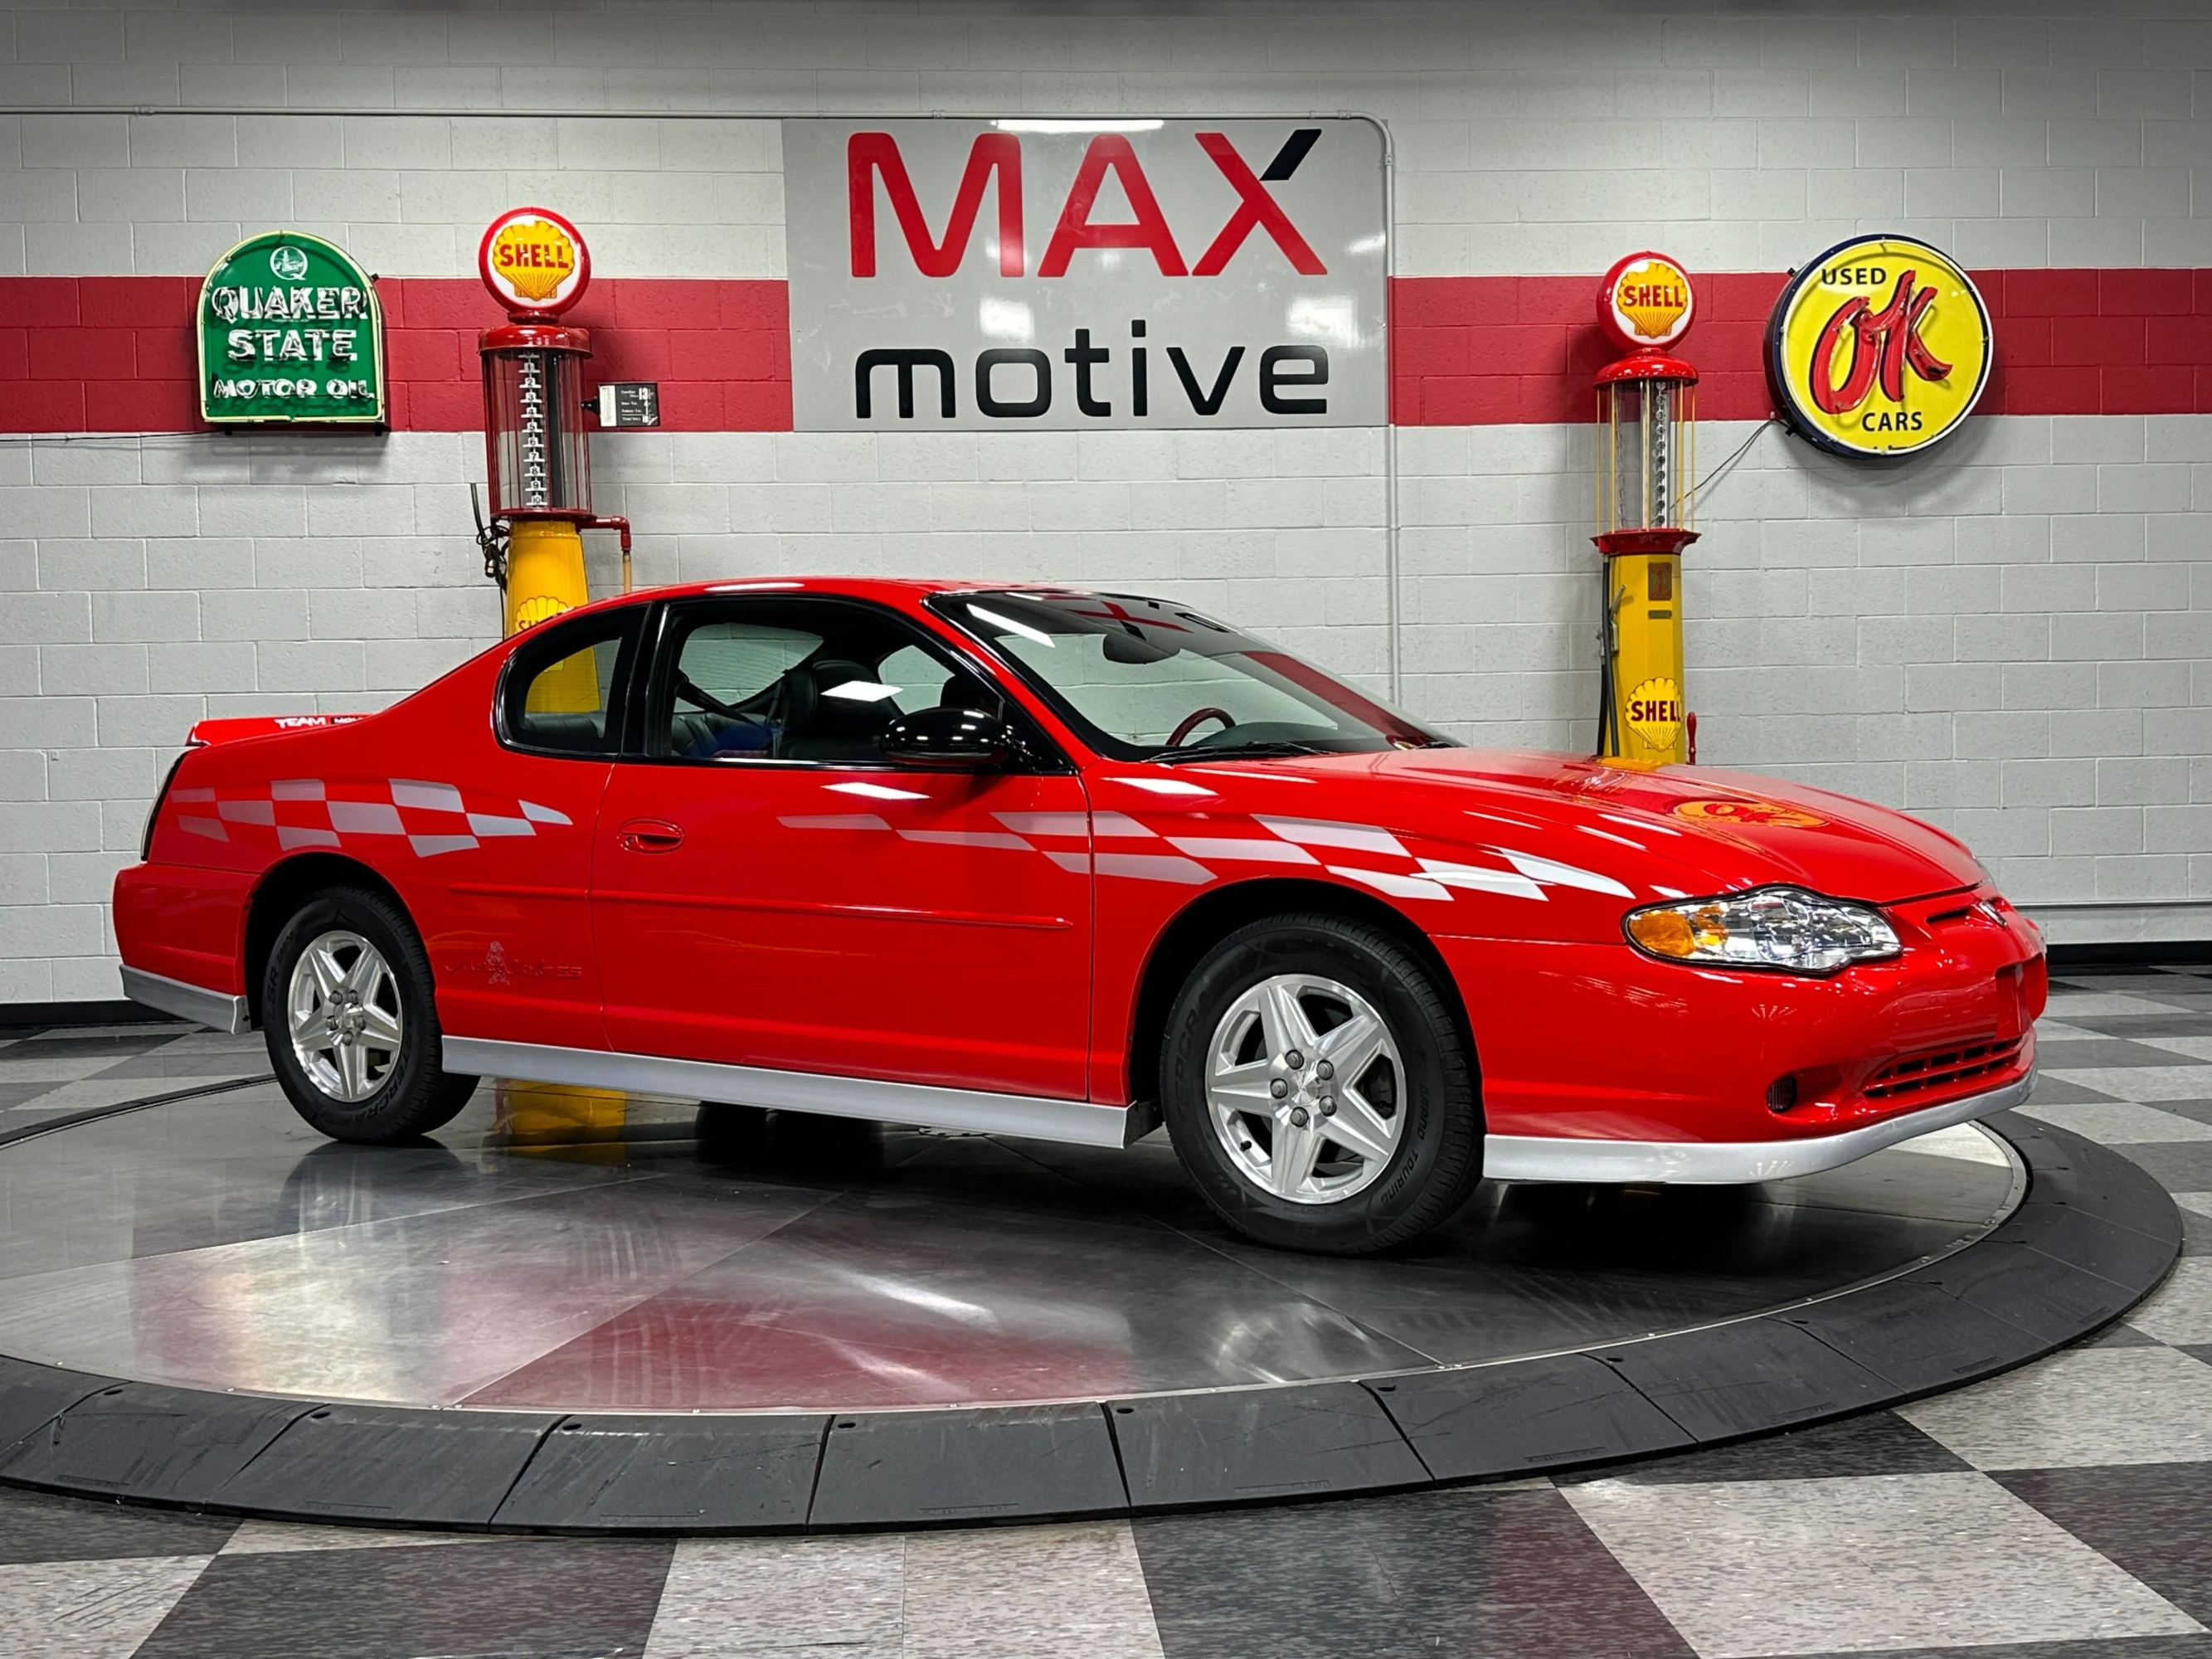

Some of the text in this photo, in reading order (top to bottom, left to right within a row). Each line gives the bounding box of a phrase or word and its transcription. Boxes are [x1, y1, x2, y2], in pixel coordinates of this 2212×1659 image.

[848, 129, 1328, 278] MAX
[499, 243, 570, 269] SHELL
[1821, 267, 1887, 285] USED
[211, 285, 369, 324] QUAKER
[1623, 285, 1684, 308] SHELL
[228, 328, 358, 362] STATE
[1809, 270, 1954, 415] OK
[855, 319, 1329, 419] motive
[213, 378, 375, 399] MOTOR OIL
[1861, 411, 1923, 431] CARS
[532, 496, 542, 504] 10
[275, 718, 326, 728] TEAM
[1631, 700, 1681, 722] SHELL
[1379, 1149, 1421, 1207] TOURING
